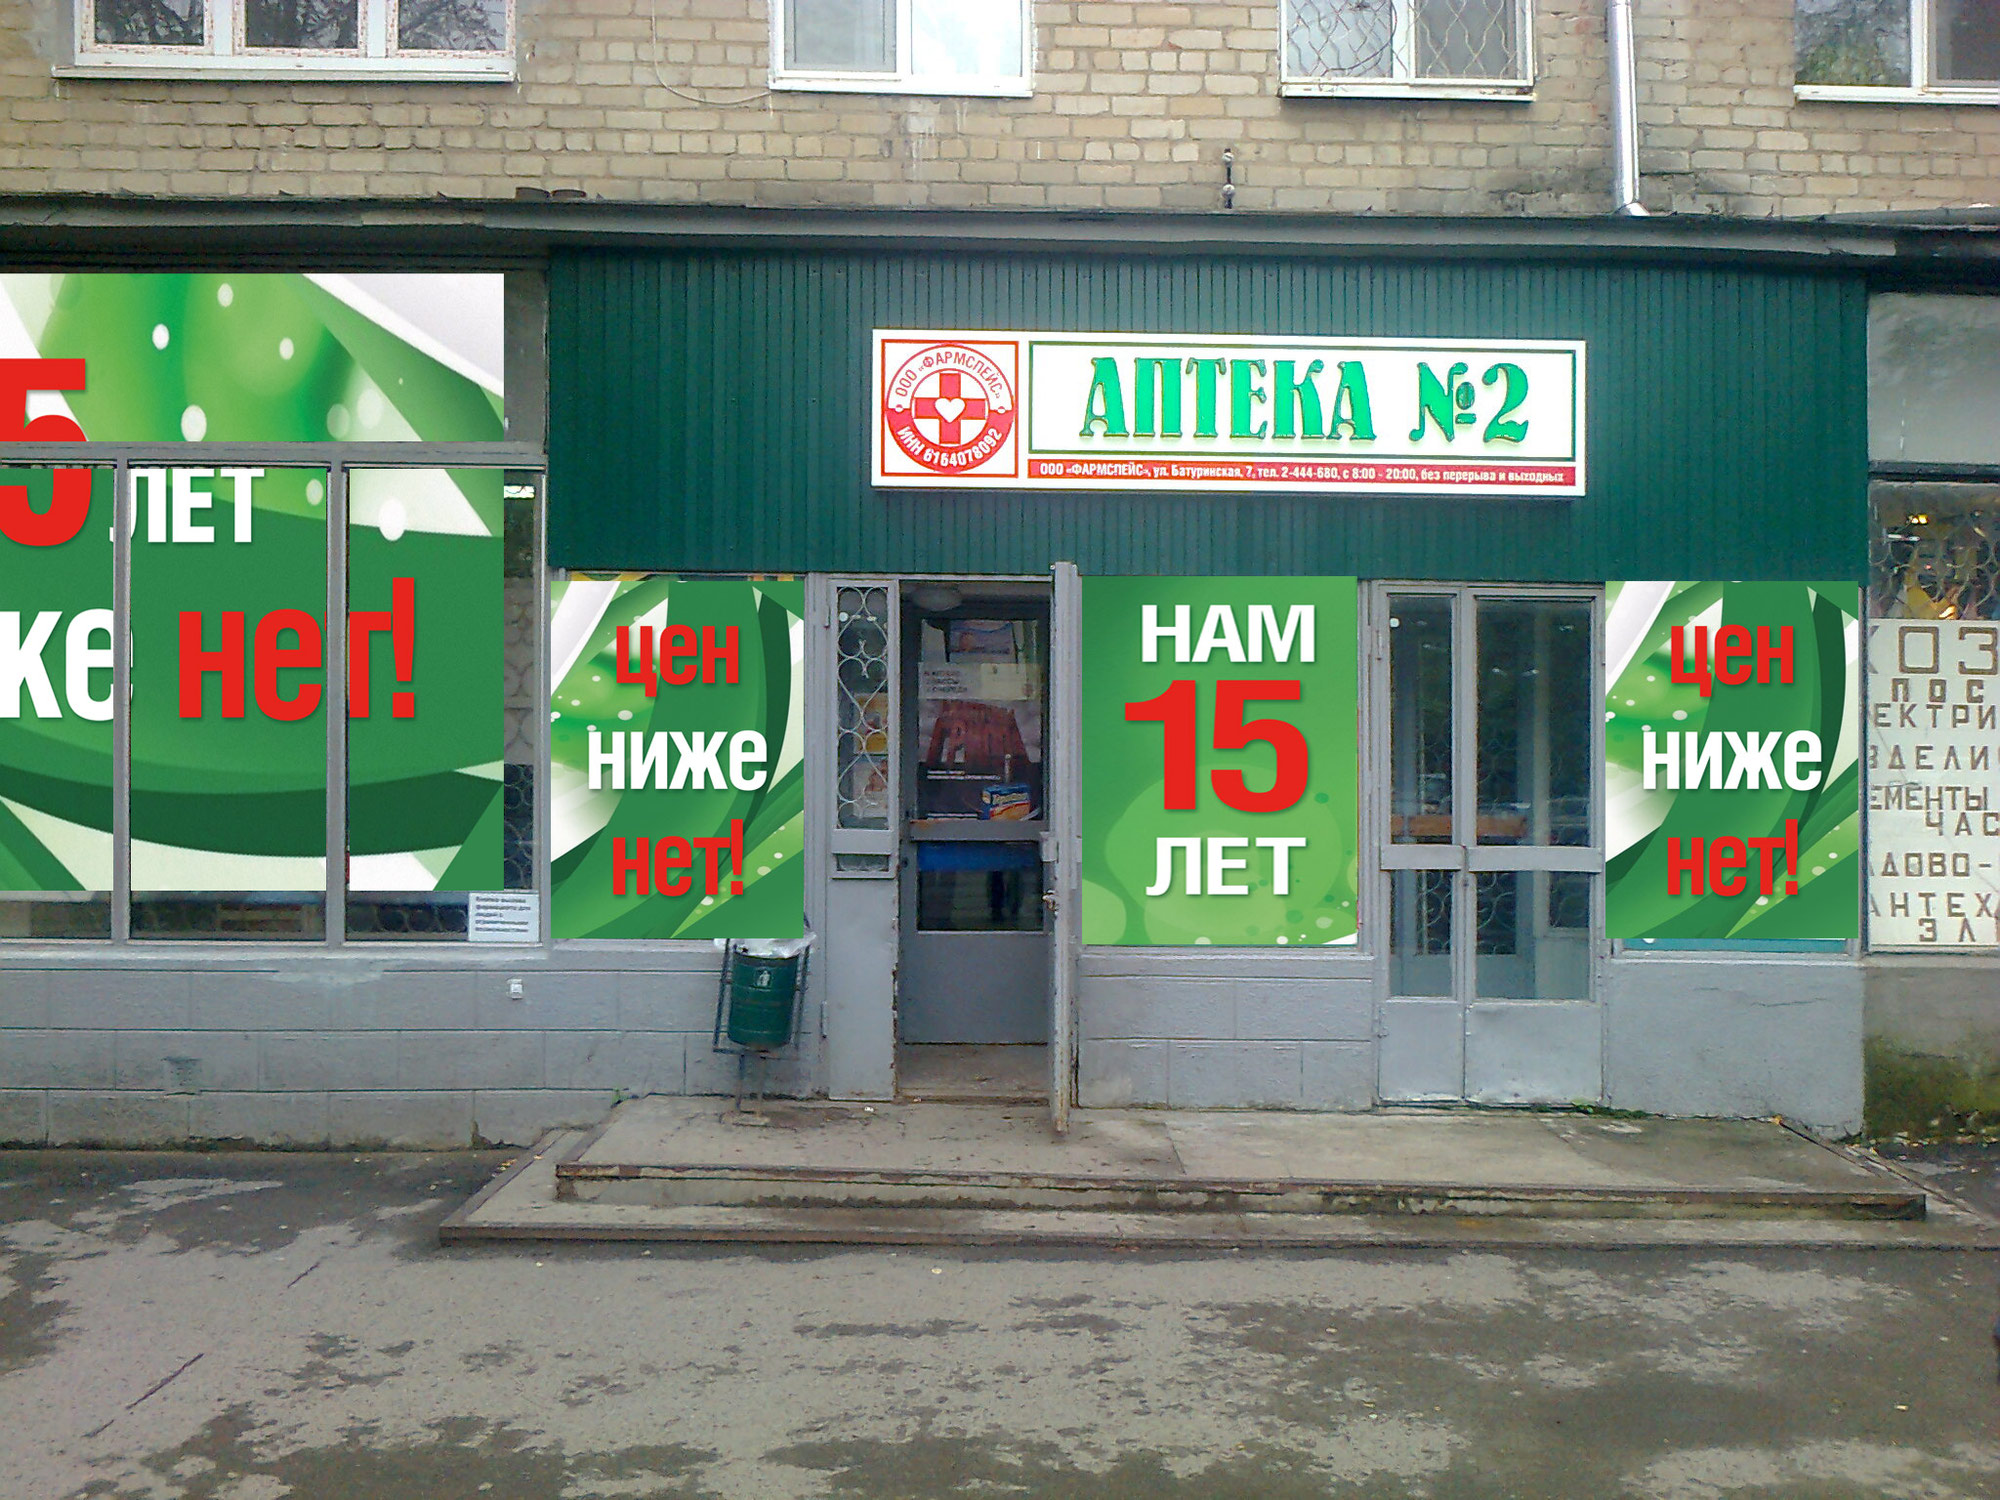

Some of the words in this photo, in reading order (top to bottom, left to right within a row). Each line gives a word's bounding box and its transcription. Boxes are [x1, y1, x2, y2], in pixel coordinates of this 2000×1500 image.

[895, 369, 917, 397] ООО
[918, 351, 1003, 399] «ФАРМСПЕЙС»
[1079, 357, 1377, 441] АПТЕКА
[1408, 360, 1529, 443] №2
[897, 426, 925, 455] ИНН
[923, 427, 1002, 467] 6164078092
[1040, 463, 1064, 475] ООО
[1153, 465, 1170, 478] ул.
[1257, 467, 1279, 478] тел.
[1281, 466, 1340, 480] 2-444-680,
[1343, 470, 1350, 479] с
[1352, 467, 1376, 479] 8:00
[1385, 467, 1419, 481] 20:00,
[1421, 468, 1440, 481] без
[1442, 470, 1496, 483] перерыва
[1499, 471, 1506, 481] и
[1508, 471, 1564, 483] выходных
[179, 577, 415, 722] нет!
[616, 624, 739, 697] цен
[1142, 605, 1315, 662] НАМ
[1671, 624, 1794, 697] цен
[588, 730, 768, 791] ниже
[1125, 680, 1308, 813] 15
[1643, 730, 1822, 791] ниже
[613, 819, 743, 897] нет!
[1146, 837, 1306, 896] ЛЕТ
[1667, 819, 1798, 897] нет!
[1869, 852, 1992, 877] ДОВО-
